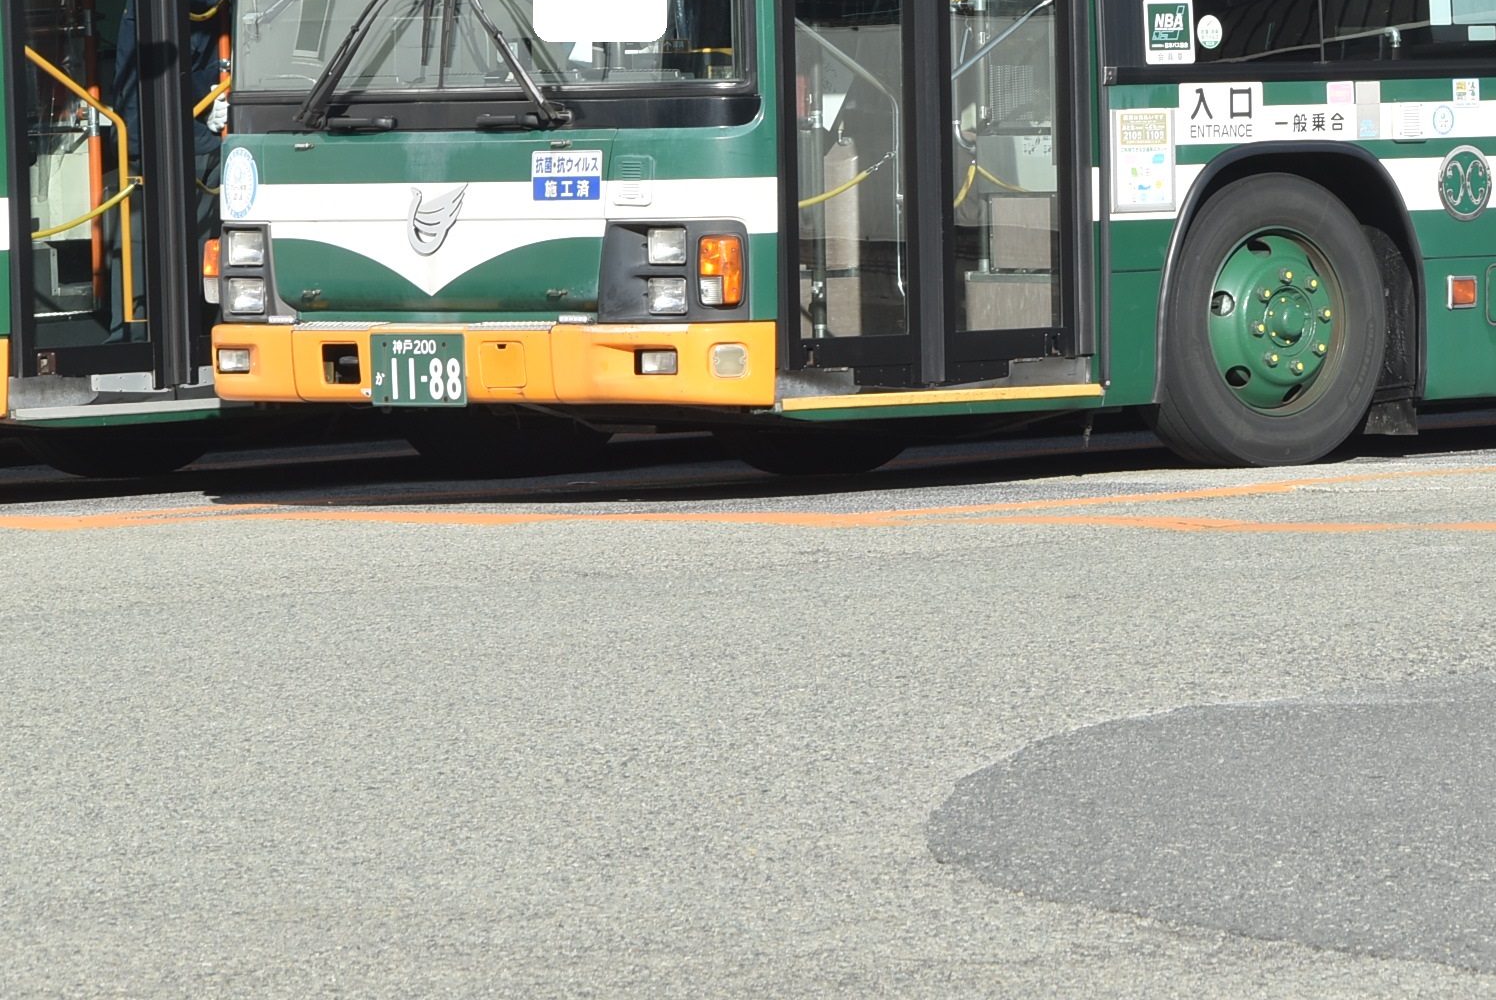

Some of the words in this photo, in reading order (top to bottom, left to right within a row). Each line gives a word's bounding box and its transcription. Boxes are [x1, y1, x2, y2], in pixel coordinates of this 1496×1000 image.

[1154, 12, 1184, 28] NBA
[1190, 87, 1252, 120] 入口
[1190, 124, 1252, 138] ENTRANCE
[1275, 112, 1344, 132] 一般乗合
[544, 180, 590, 198] 施工済
[391, 358, 462, 400] 11-88
